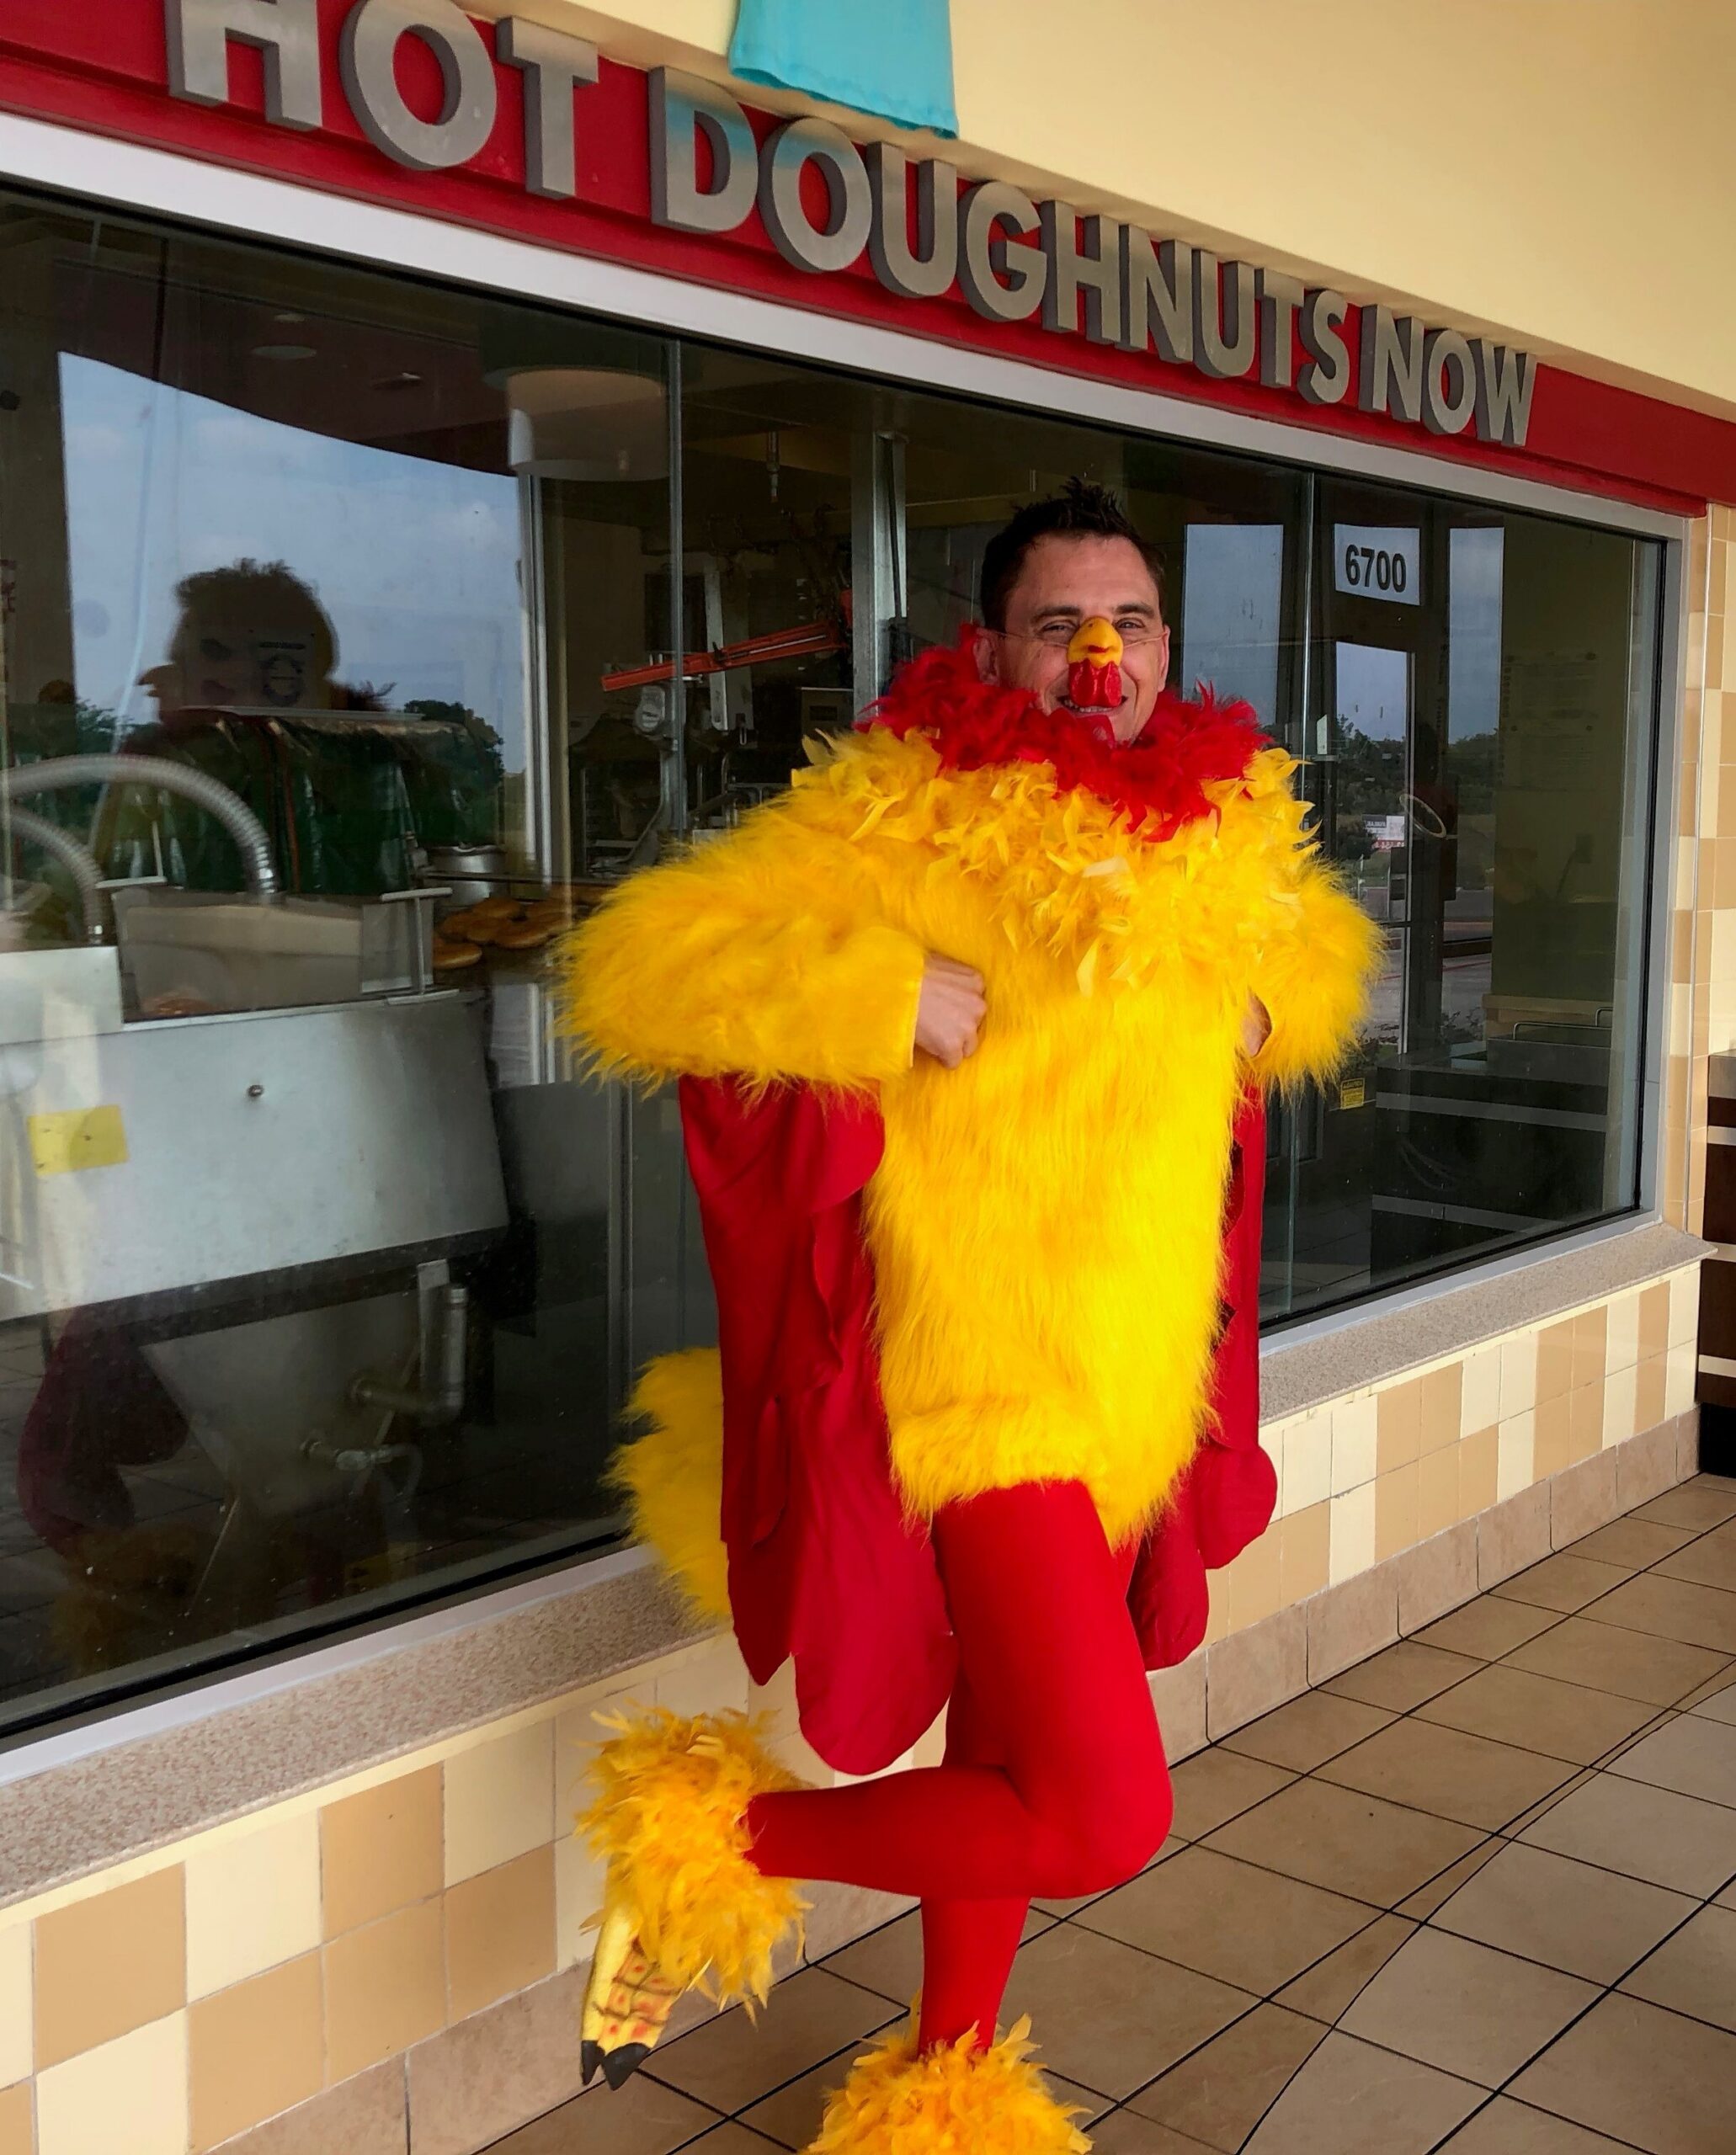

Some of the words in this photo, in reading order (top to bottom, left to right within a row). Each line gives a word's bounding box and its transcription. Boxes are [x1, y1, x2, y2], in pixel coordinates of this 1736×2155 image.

[164, 0, 599, 200] HOT
[647, 66, 1350, 406] DOUGHNUTS
[1358, 304, 1538, 447] NOW
[1345, 544, 1407, 593] 6700
